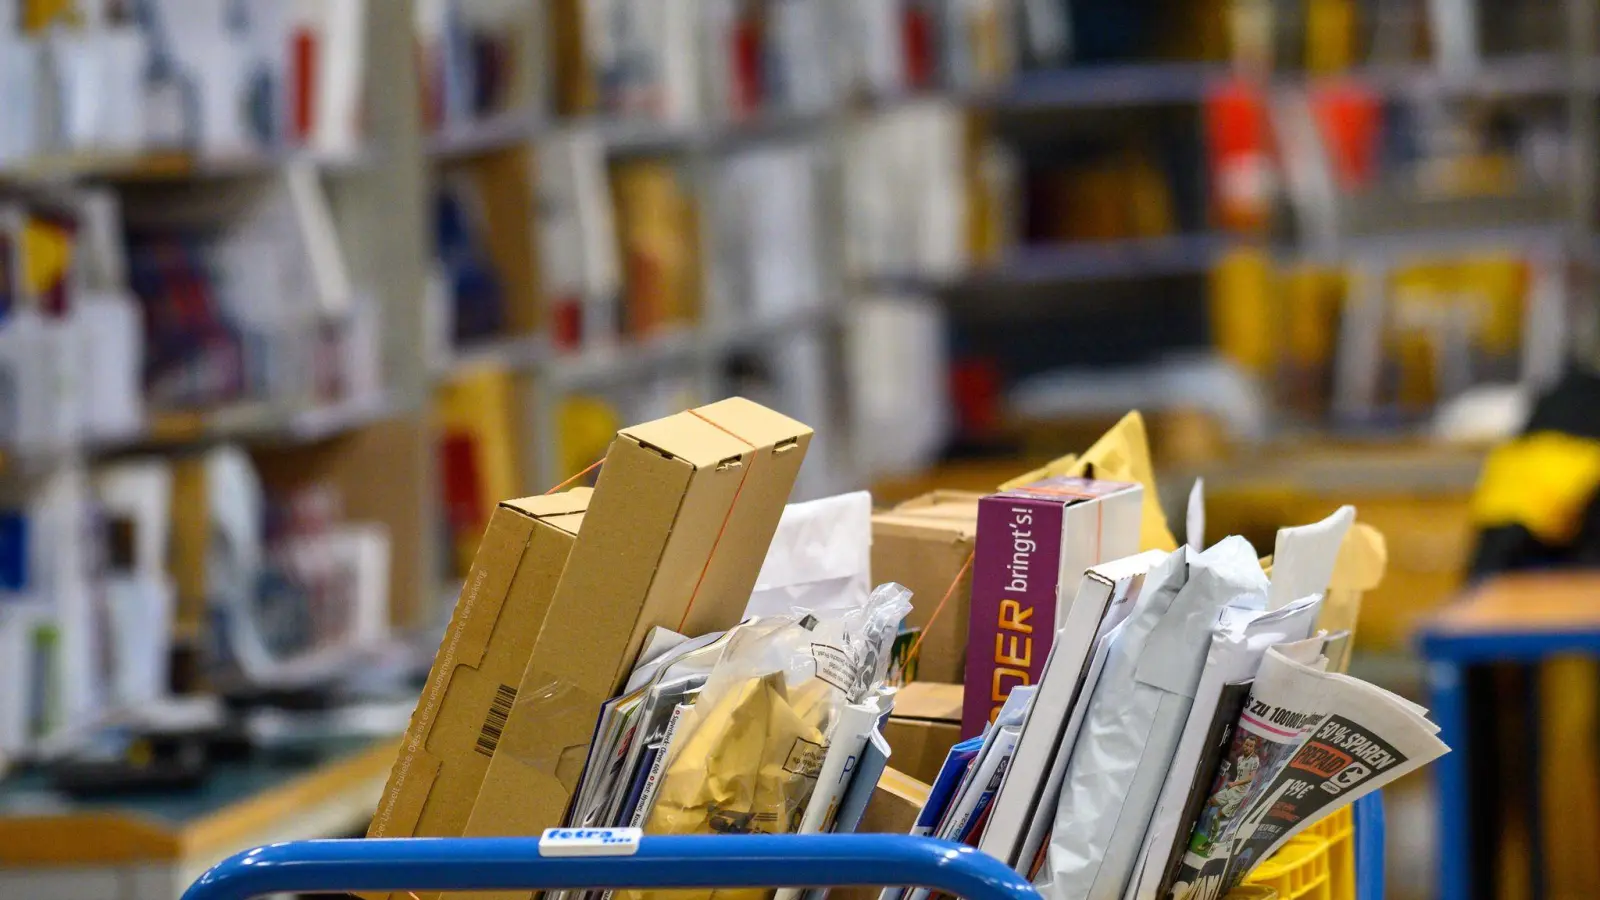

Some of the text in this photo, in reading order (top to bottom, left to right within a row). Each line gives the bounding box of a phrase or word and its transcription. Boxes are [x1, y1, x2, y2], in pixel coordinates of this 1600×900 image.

[990, 599, 1034, 725] DER
[1250, 700, 1271, 717] zu
[1340, 733, 1396, 770] SPAREN
